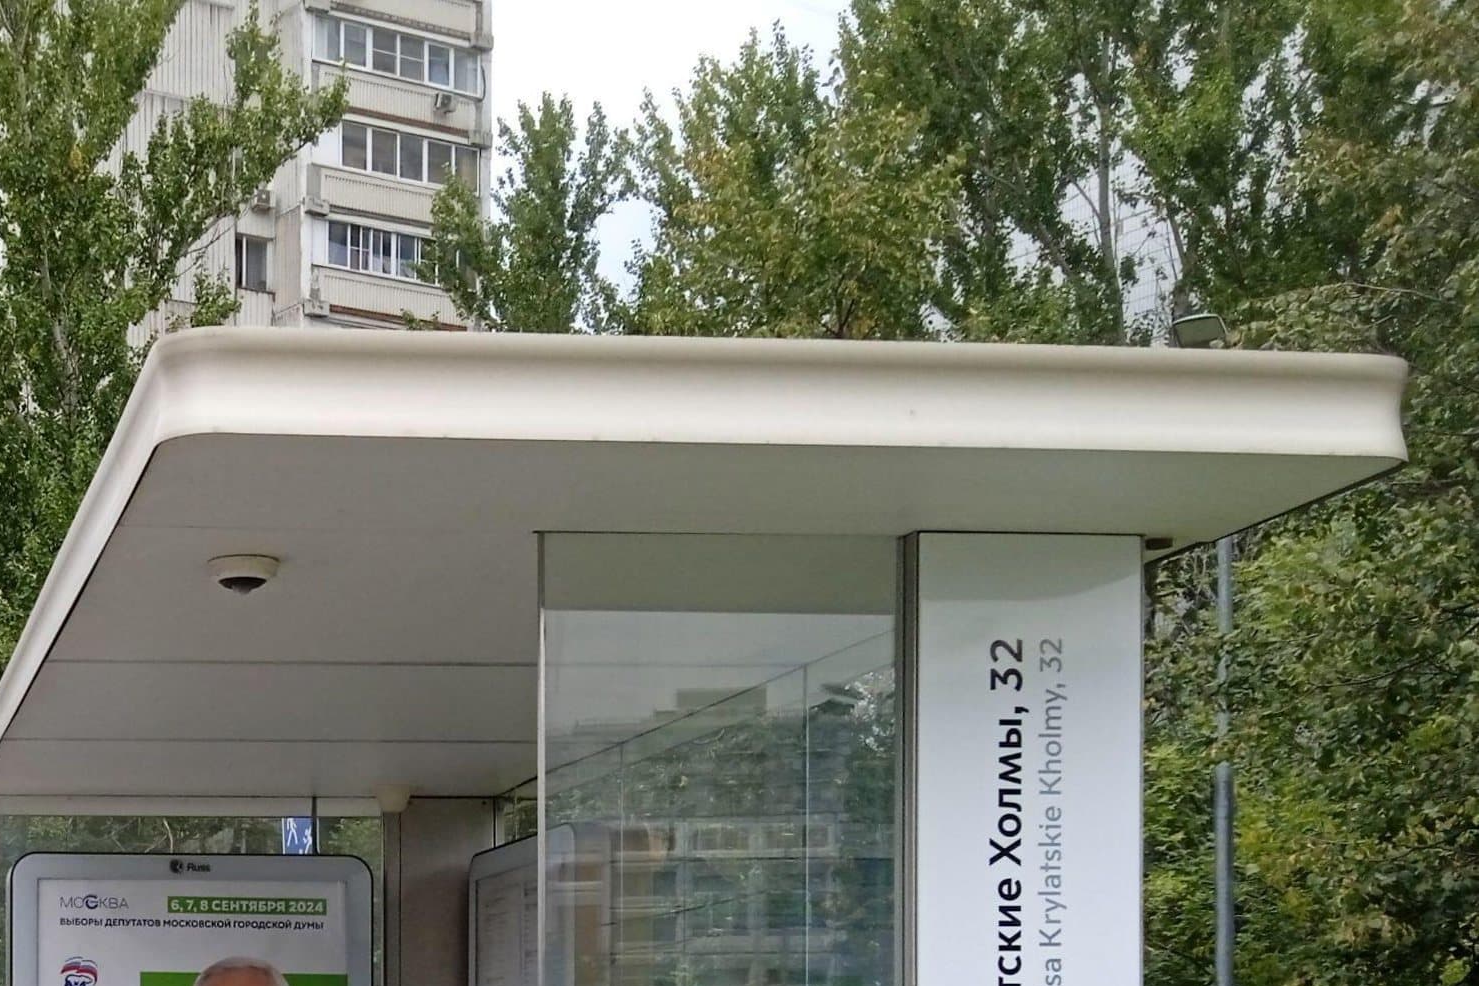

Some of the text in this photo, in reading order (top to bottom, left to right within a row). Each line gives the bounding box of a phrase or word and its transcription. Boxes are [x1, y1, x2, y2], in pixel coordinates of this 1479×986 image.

[989, 638, 1023, 691] 32
[1039, 638, 1063, 673] 32
[1038, 683, 1067, 795] Kholmy,
[989, 706, 1029, 866] Холмы,
[1038, 806, 1067, 947] Krylatskie
[60, 894, 129, 909] МОСКВА
[171, 900, 323, 913] 6, 7, 8 СЕНТЯБРЯ 2024
[60, 918, 324, 930] ВЫБОРЫ ДЕПУТАТОВ МОСКОВСКОЙ ГОРОДСКОЙ ДУМЫ
